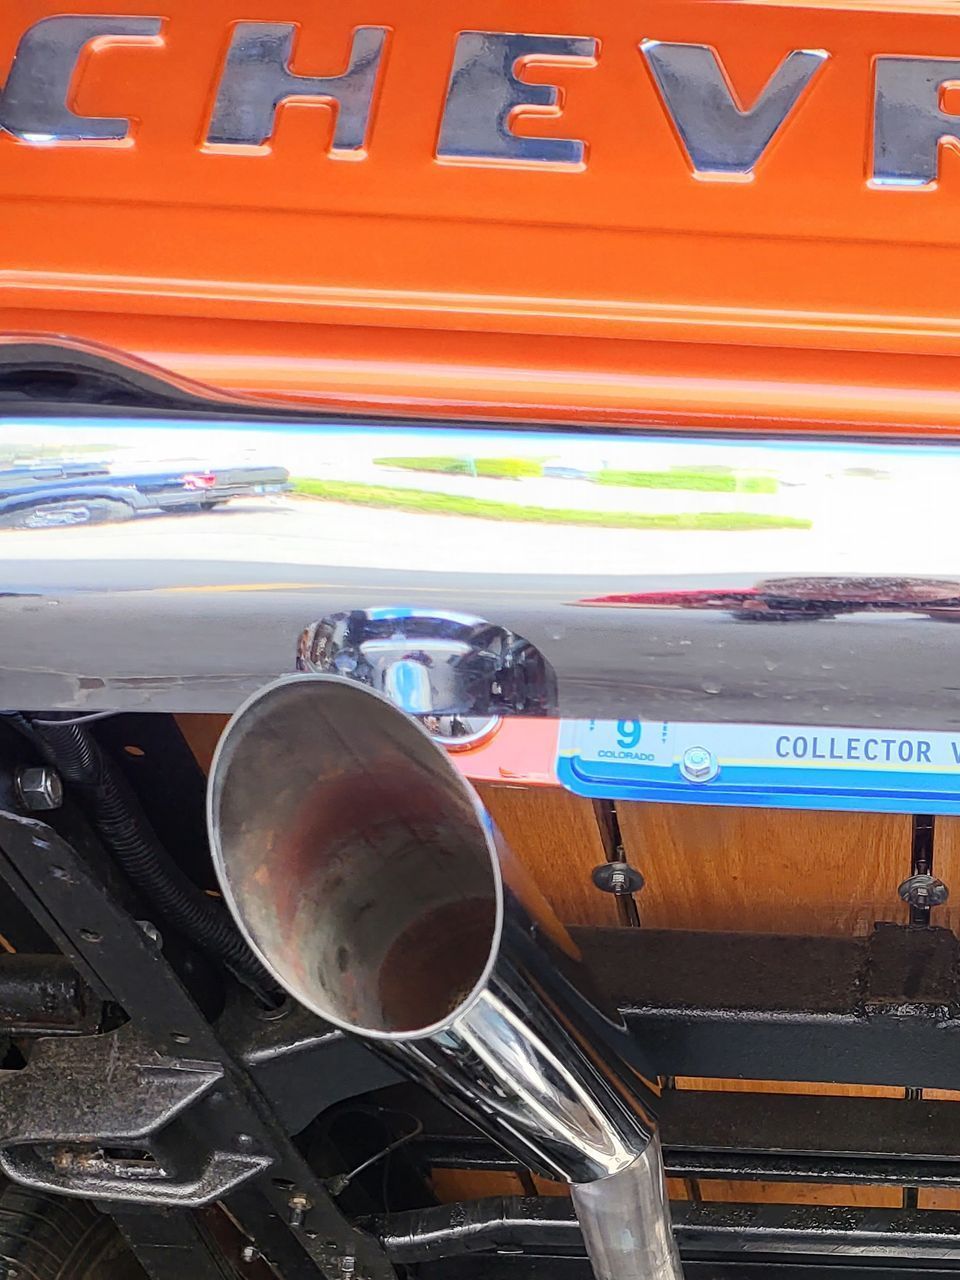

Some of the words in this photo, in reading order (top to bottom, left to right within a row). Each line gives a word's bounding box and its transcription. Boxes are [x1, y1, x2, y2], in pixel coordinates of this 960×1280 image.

[616, 718, 642, 748] 9
[597, 749, 655, 761] COLORADO
[775, 735, 932, 763] COLLECTOR
